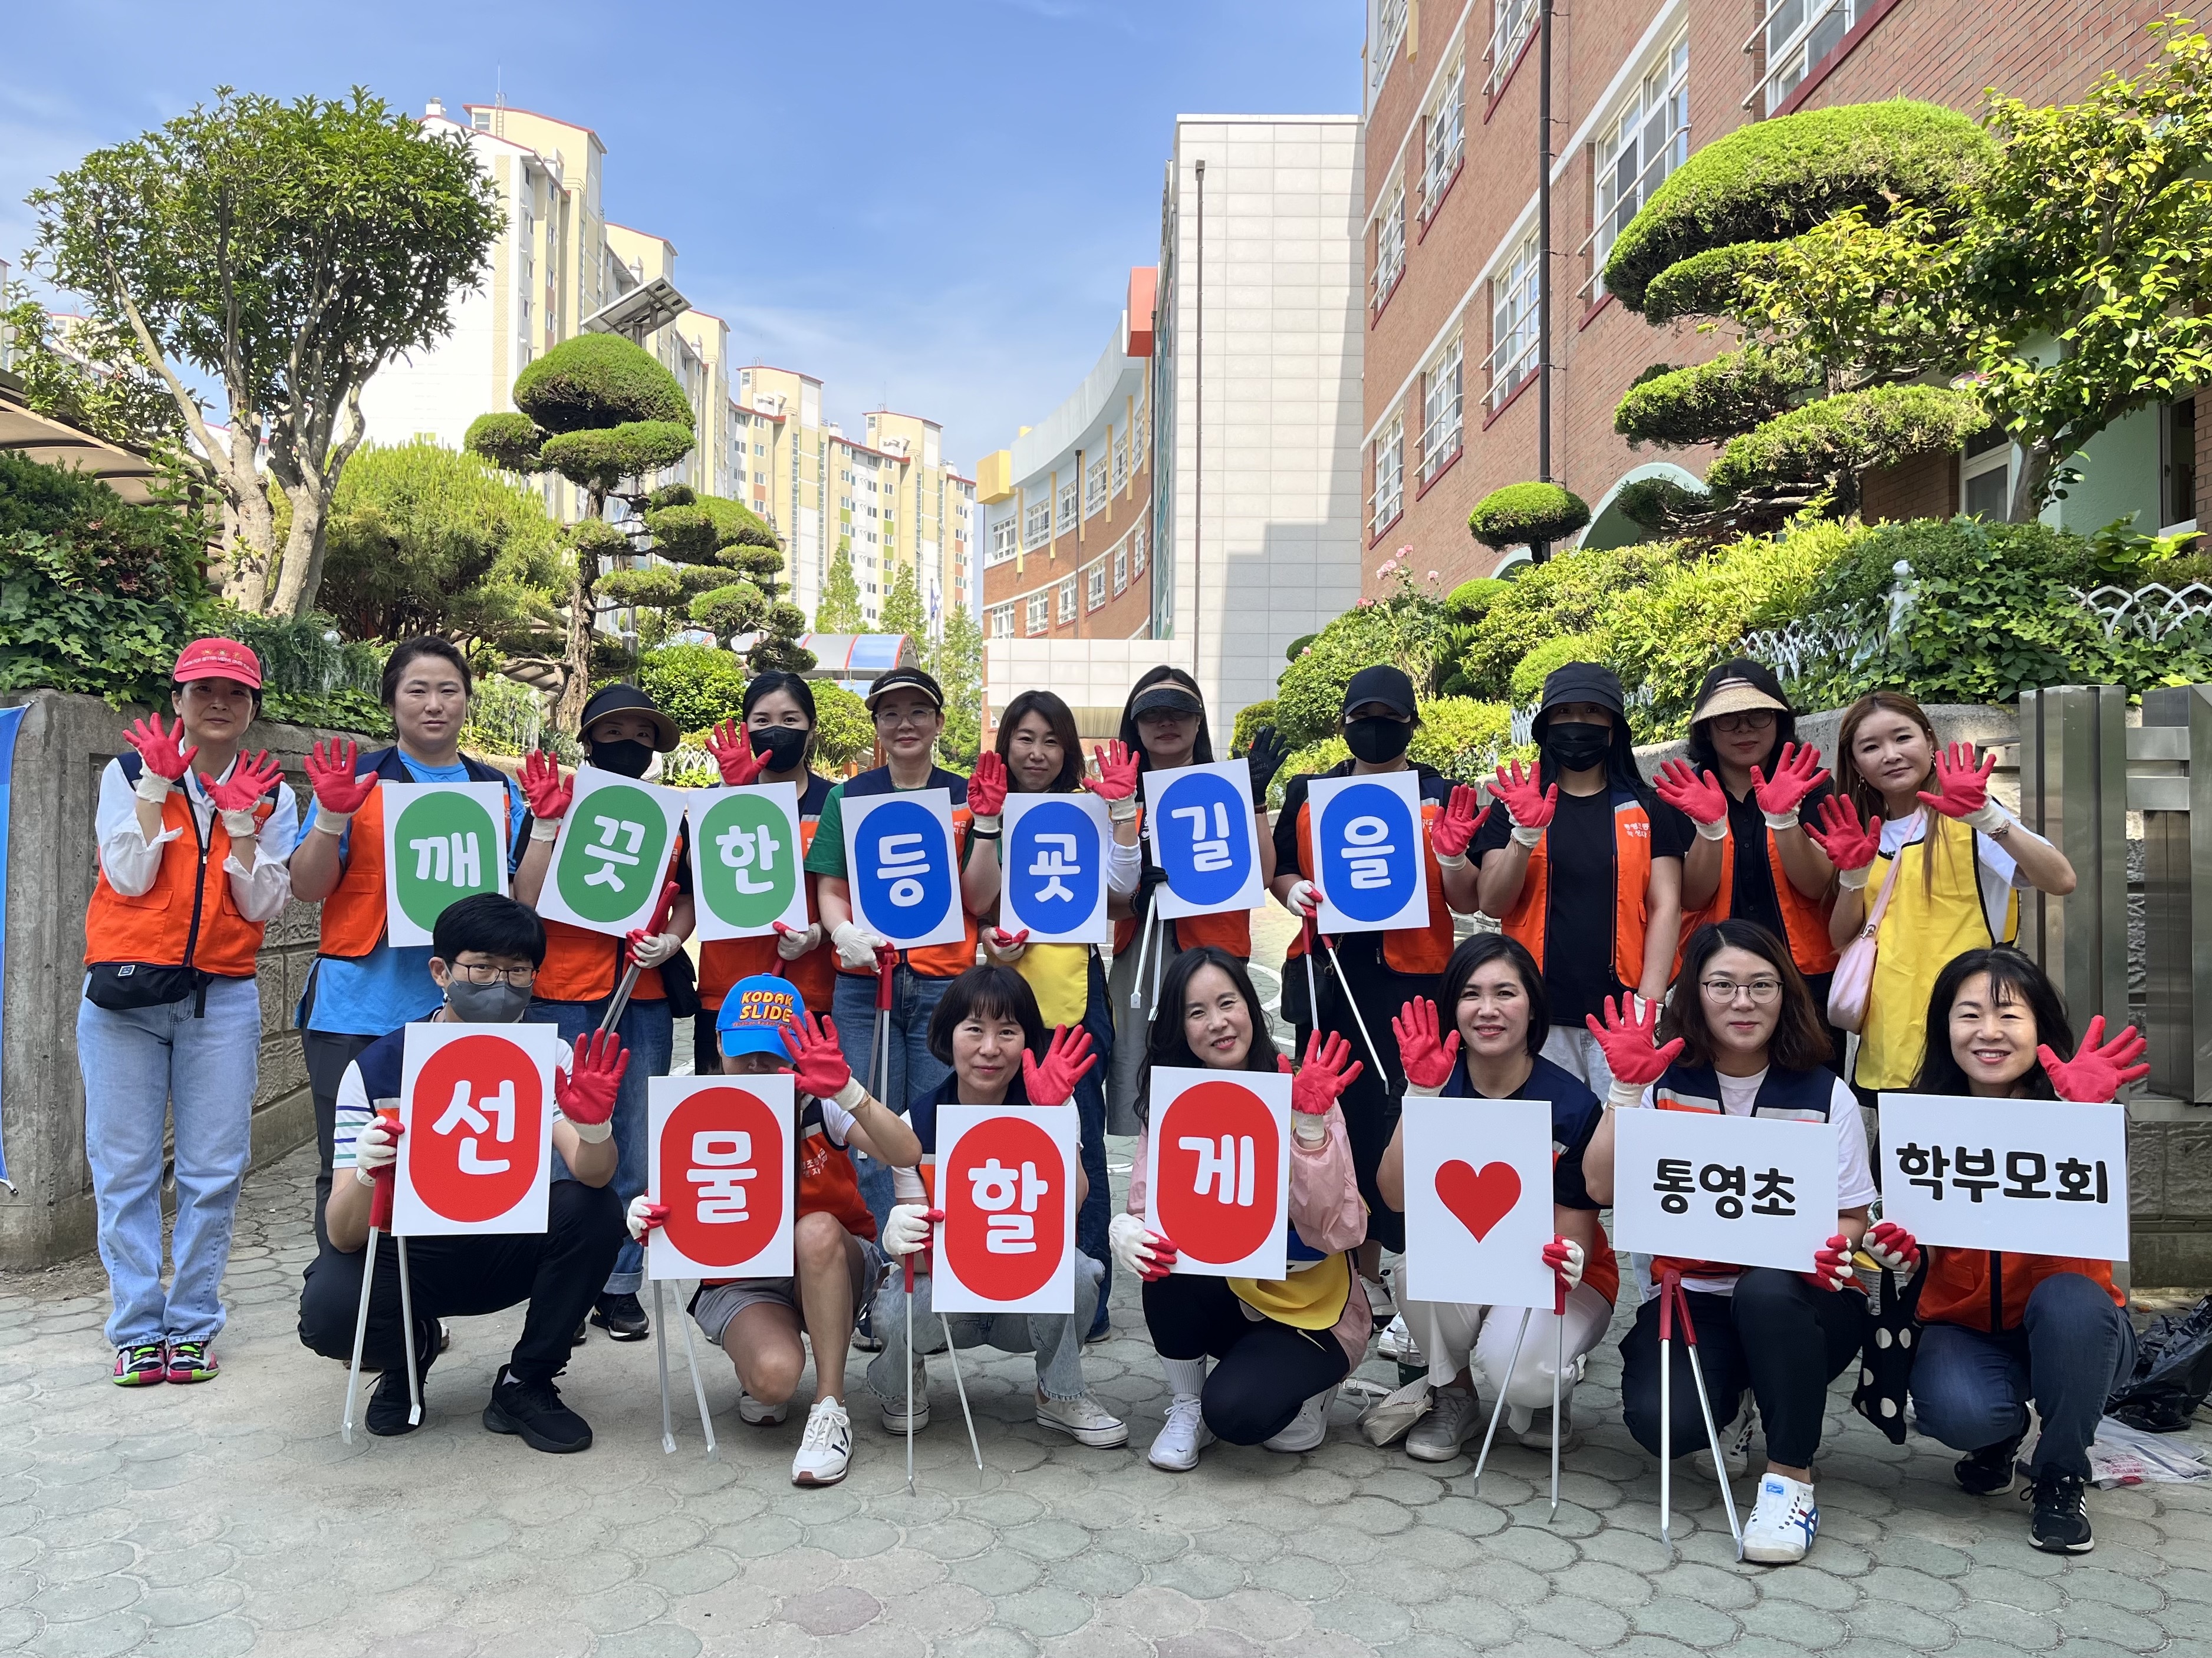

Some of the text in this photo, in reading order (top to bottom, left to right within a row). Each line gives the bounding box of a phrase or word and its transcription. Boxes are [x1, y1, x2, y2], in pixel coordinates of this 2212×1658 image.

[410, 832, 480, 887] 깨
[584, 816, 646, 892] 끗
[716, 825, 779, 894] 한
[877, 833, 930, 907] 등
[1029, 833, 1081, 902] 굣
[1172, 802, 1232, 872] 길
[1341, 816, 1395, 889] 을
[739, 1004, 793, 1023] SLIDE
[740, 991, 794, 1007] KODAK
[432, 1080, 515, 1175] 선
[687, 1130, 757, 1224] 물
[1179, 1134, 1255, 1207] 게
[1653, 1158, 1796, 1219] 통영초
[1896, 1142, 2108, 1204] 학부모회
[968, 1158, 1048, 1254] 할
